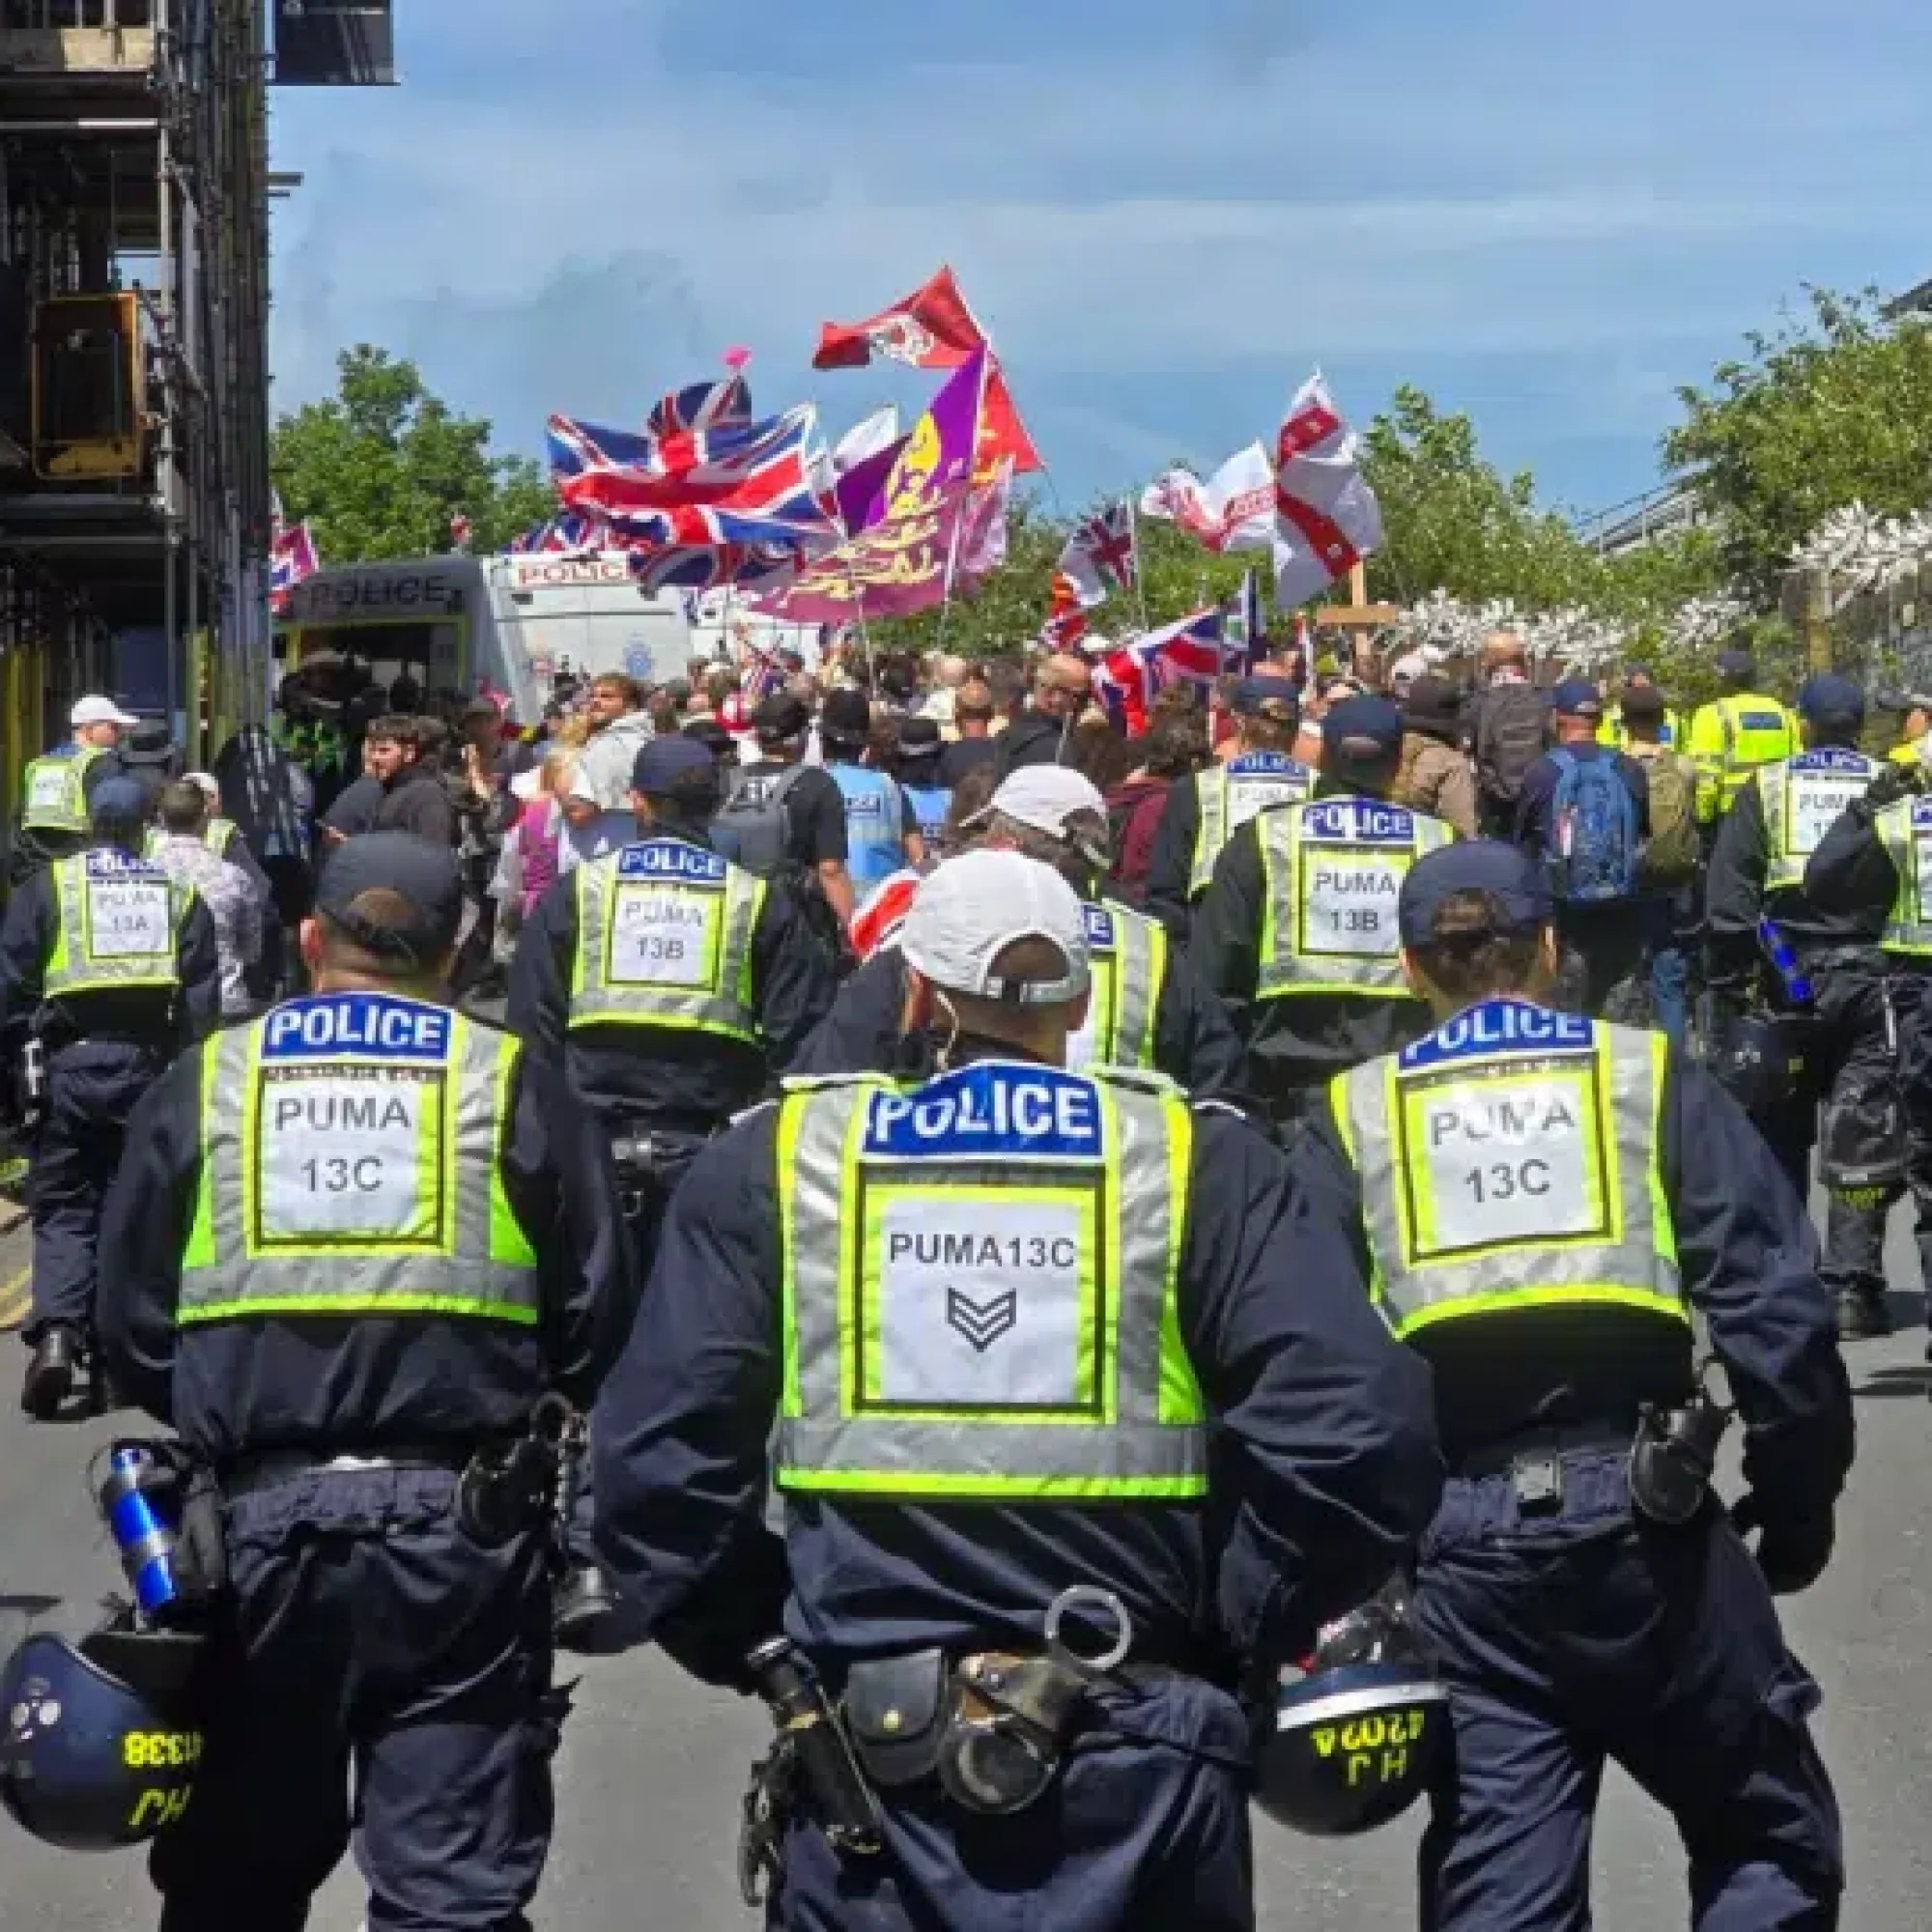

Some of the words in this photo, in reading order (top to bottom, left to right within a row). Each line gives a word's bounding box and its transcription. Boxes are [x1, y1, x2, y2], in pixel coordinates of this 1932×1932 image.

[518, 557, 631, 585] POLIC
[309, 575, 445, 609] POLICE
[1304, 804, 1410, 837] POLICE
[621, 846, 724, 877] POLICE
[1314, 871, 1396, 895] PUMA
[111, 915, 150, 931] 13A
[624, 900, 703, 928] PUMA
[1330, 908, 1378, 931] 13B
[637, 936, 685, 960] 13B
[270, 1004, 441, 1050] POLICE
[275, 1096, 412, 1131] PUMA
[874, 1079, 1095, 1144] POLICE
[1430, 1096, 1577, 1147] PUMA
[299, 1154, 384, 1193] 13C
[1463, 1158, 1551, 1204] 13C
